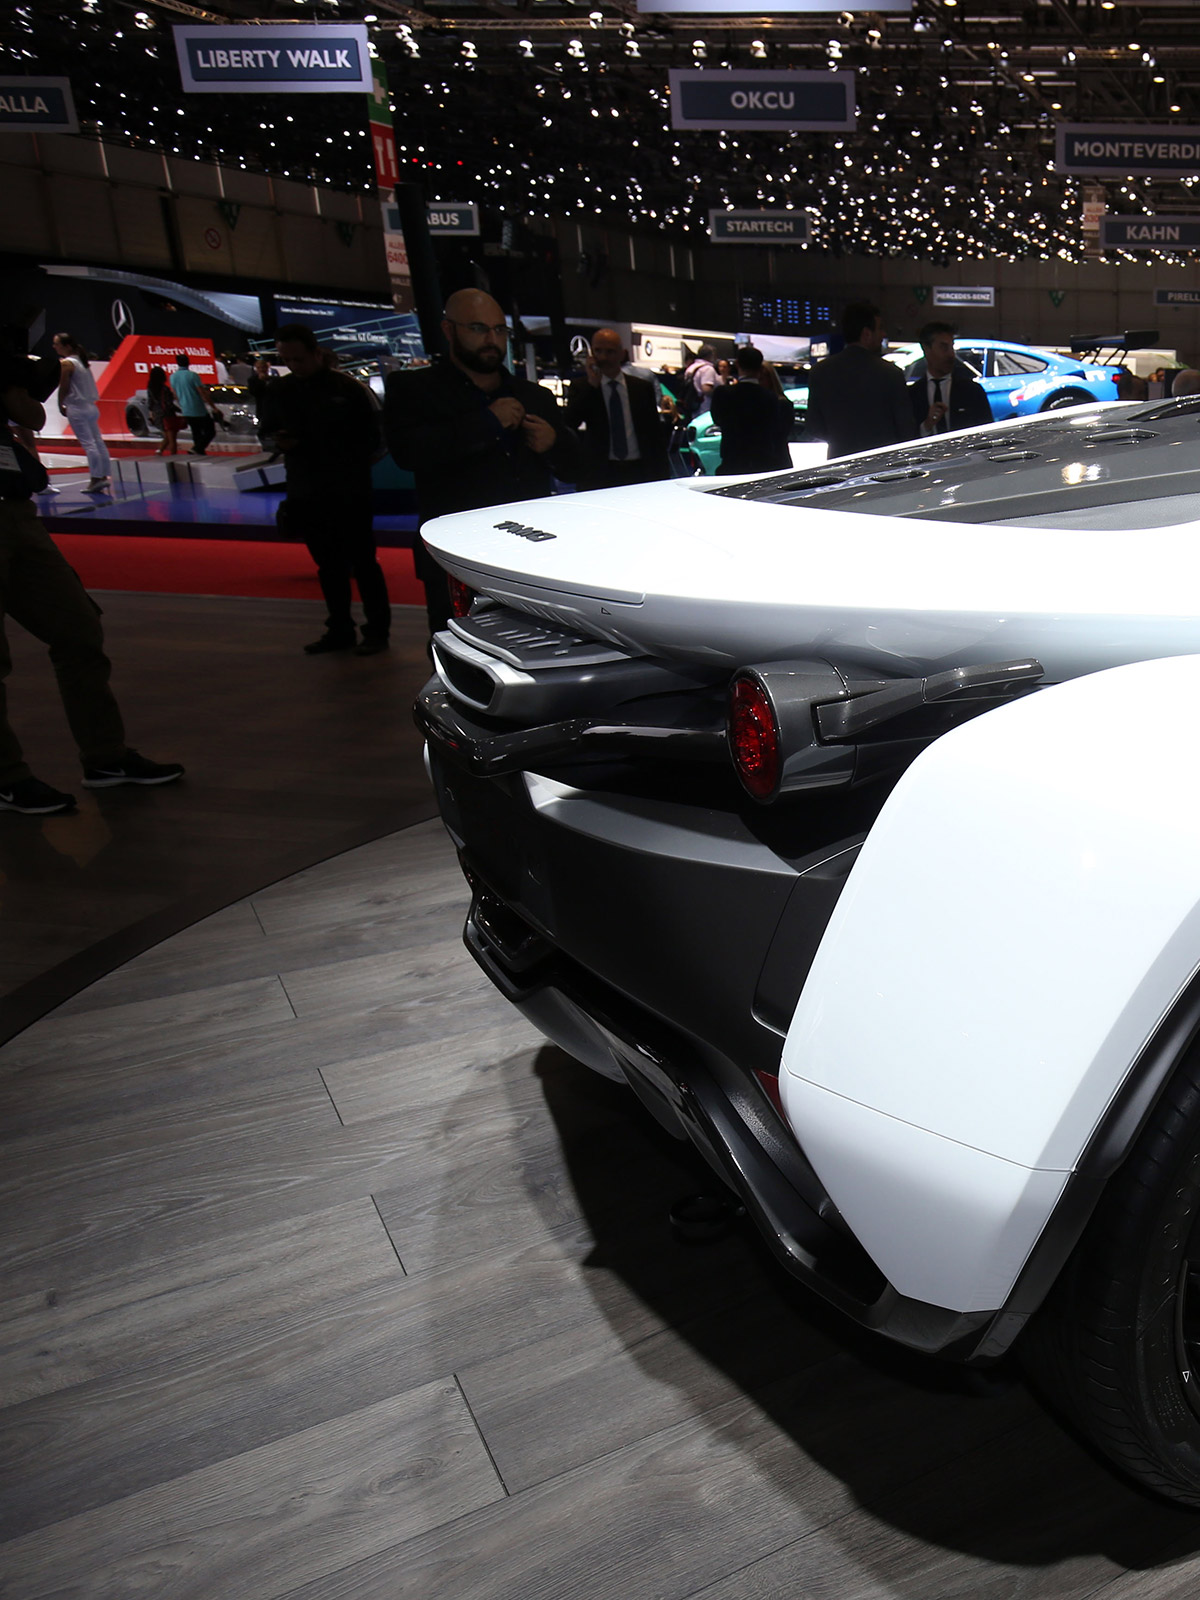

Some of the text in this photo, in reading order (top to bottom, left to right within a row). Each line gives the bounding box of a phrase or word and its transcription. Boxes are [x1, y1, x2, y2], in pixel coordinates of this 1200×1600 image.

[196, 49, 353, 69] LIBERTY WALK
[730, 90, 796, 110] OKCU
[1073, 140, 1200, 160] MONTEVERDI
[726, 220, 794, 233] STARTECH
[1126, 225, 1180, 241] KAHN
[936, 292, 991, 301] MERCEDES-BENZ
[147, 345, 211, 357] Liberty Walk
